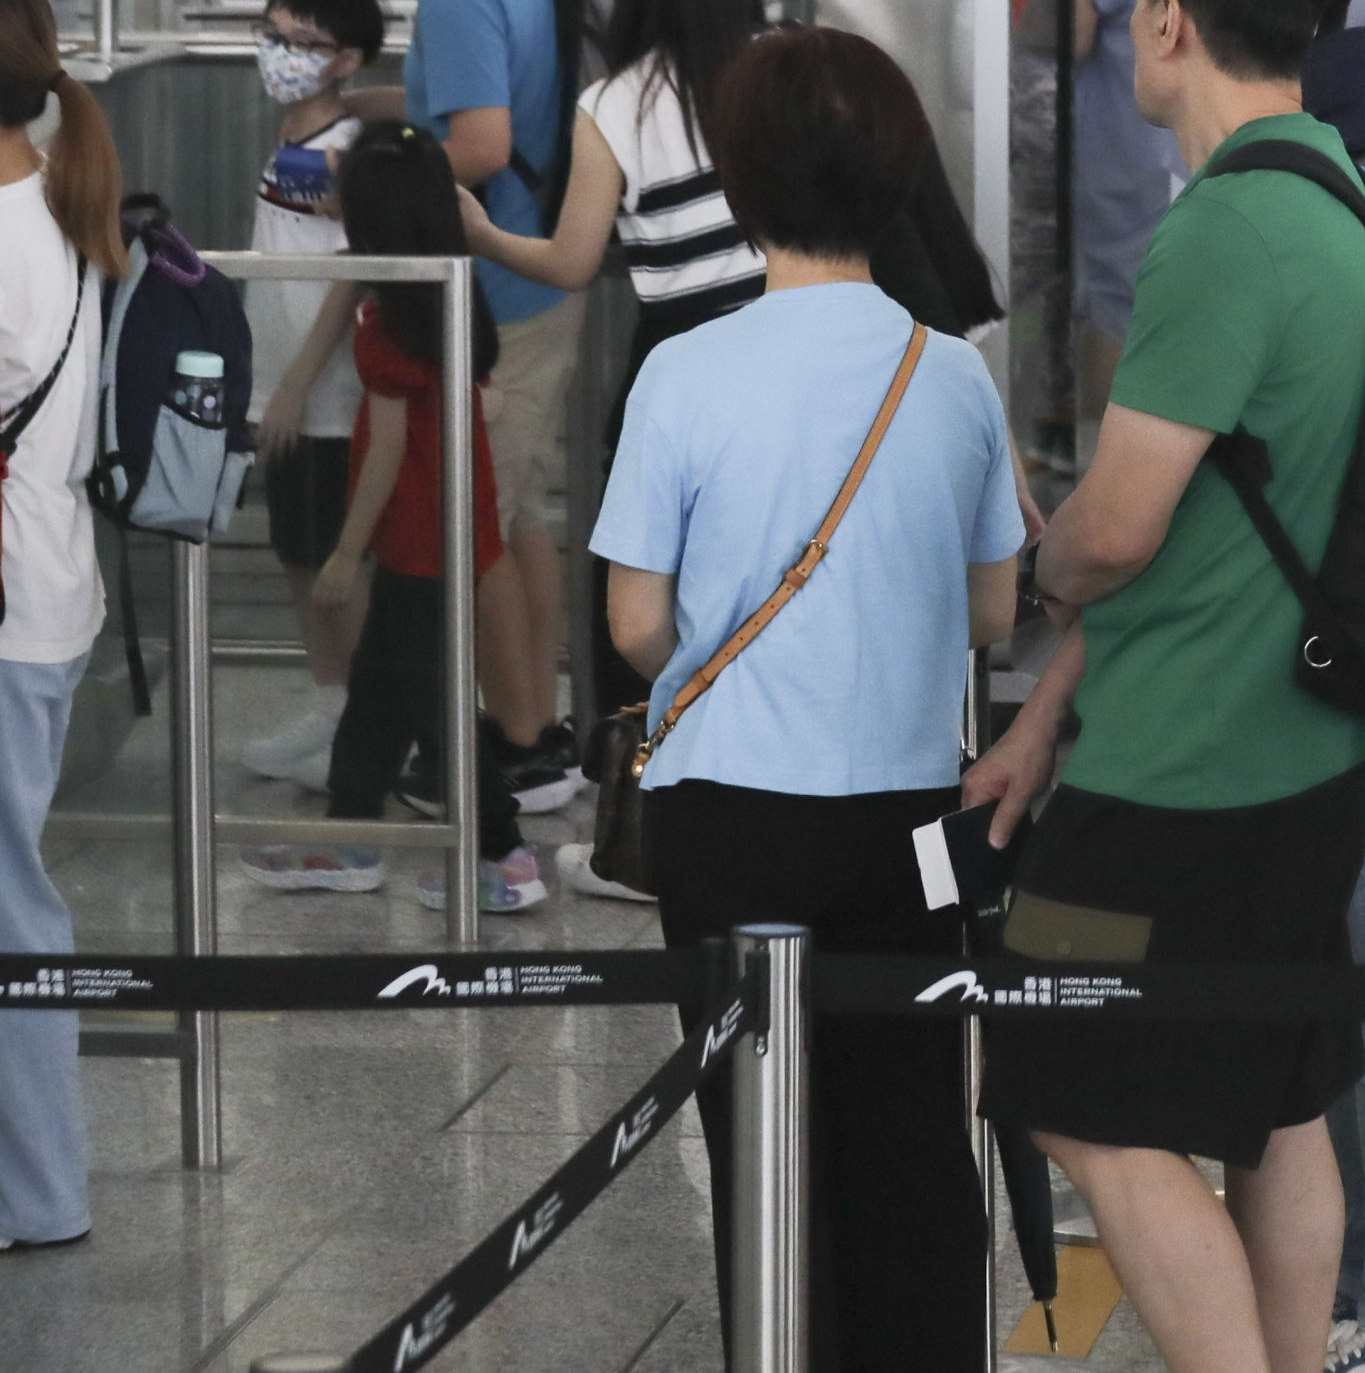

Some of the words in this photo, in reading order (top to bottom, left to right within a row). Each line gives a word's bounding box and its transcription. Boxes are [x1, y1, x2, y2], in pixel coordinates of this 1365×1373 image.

[104, 970, 133, 978] KONG
[520, 966, 550, 974] HONG
[552, 965, 582, 973] KONG
[72, 979, 153, 988] INTERNATIONAL
[520, 974, 603, 984] INTERNATIONAL
[1060, 978, 1089, 986] HONG
[1092, 977, 1122, 985] KONG
[72, 988, 117, 997] AIRPORT
[521, 985, 566, 994] AIRPORT
[1060, 988, 1143, 996] INTERNATIONAL
[1060, 998, 1105, 1006] AIRPORT
